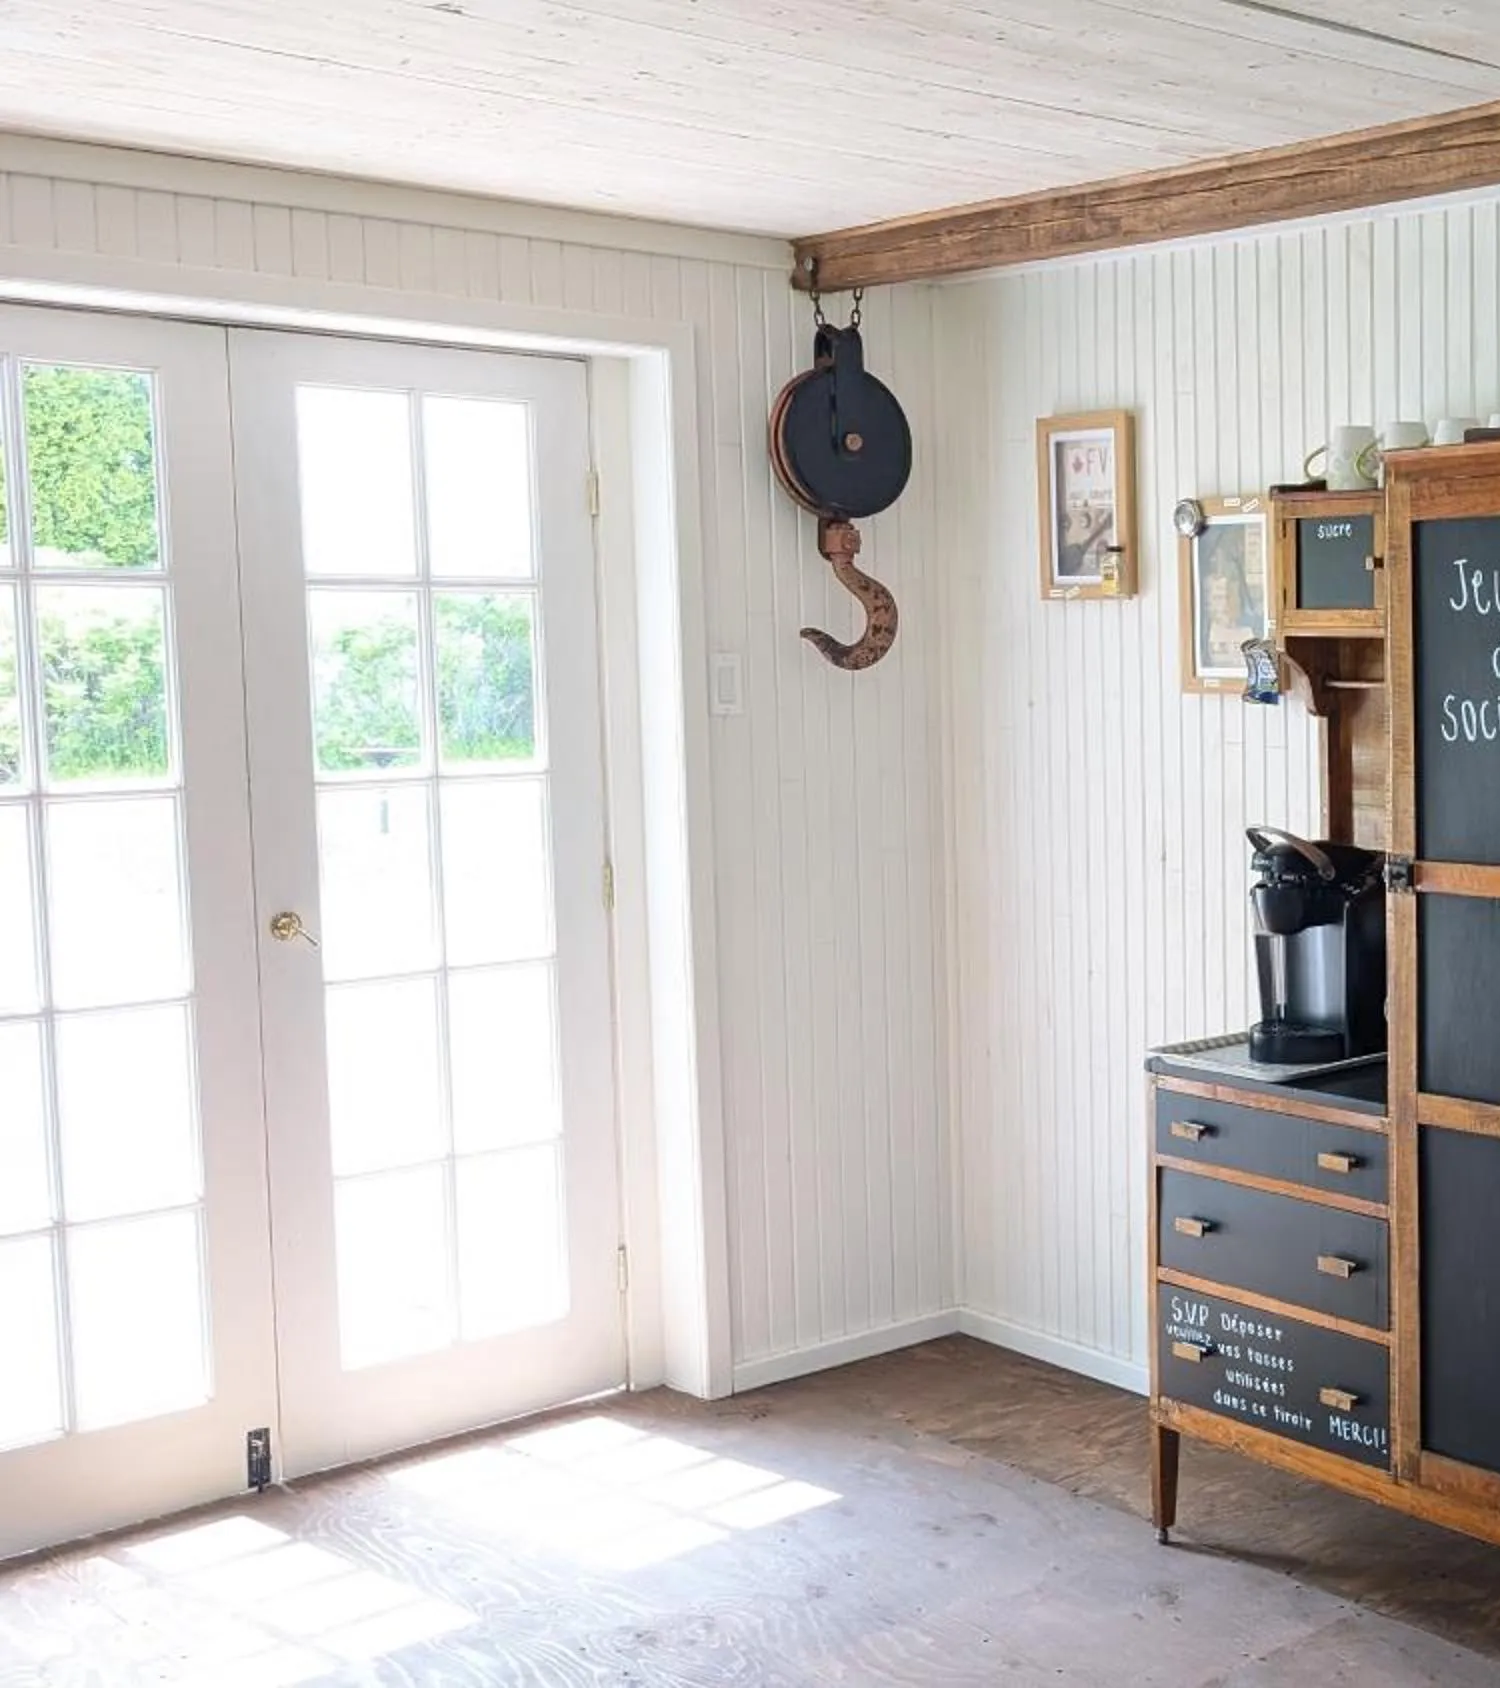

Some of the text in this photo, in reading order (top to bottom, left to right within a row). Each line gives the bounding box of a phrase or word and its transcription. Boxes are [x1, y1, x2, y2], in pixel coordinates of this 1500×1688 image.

[1317, 523, 1352, 539] sucre
[1221, 1312, 1283, 1341] Déposer
[1217, 1343, 1295, 1372] vos tasses
[1225, 1368, 1286, 1397] utilisées
[1212, 1388, 1248, 1411] dans
[1251, 1402, 1267, 1417] ce
[1273, 1405, 1313, 1432] tiroir
